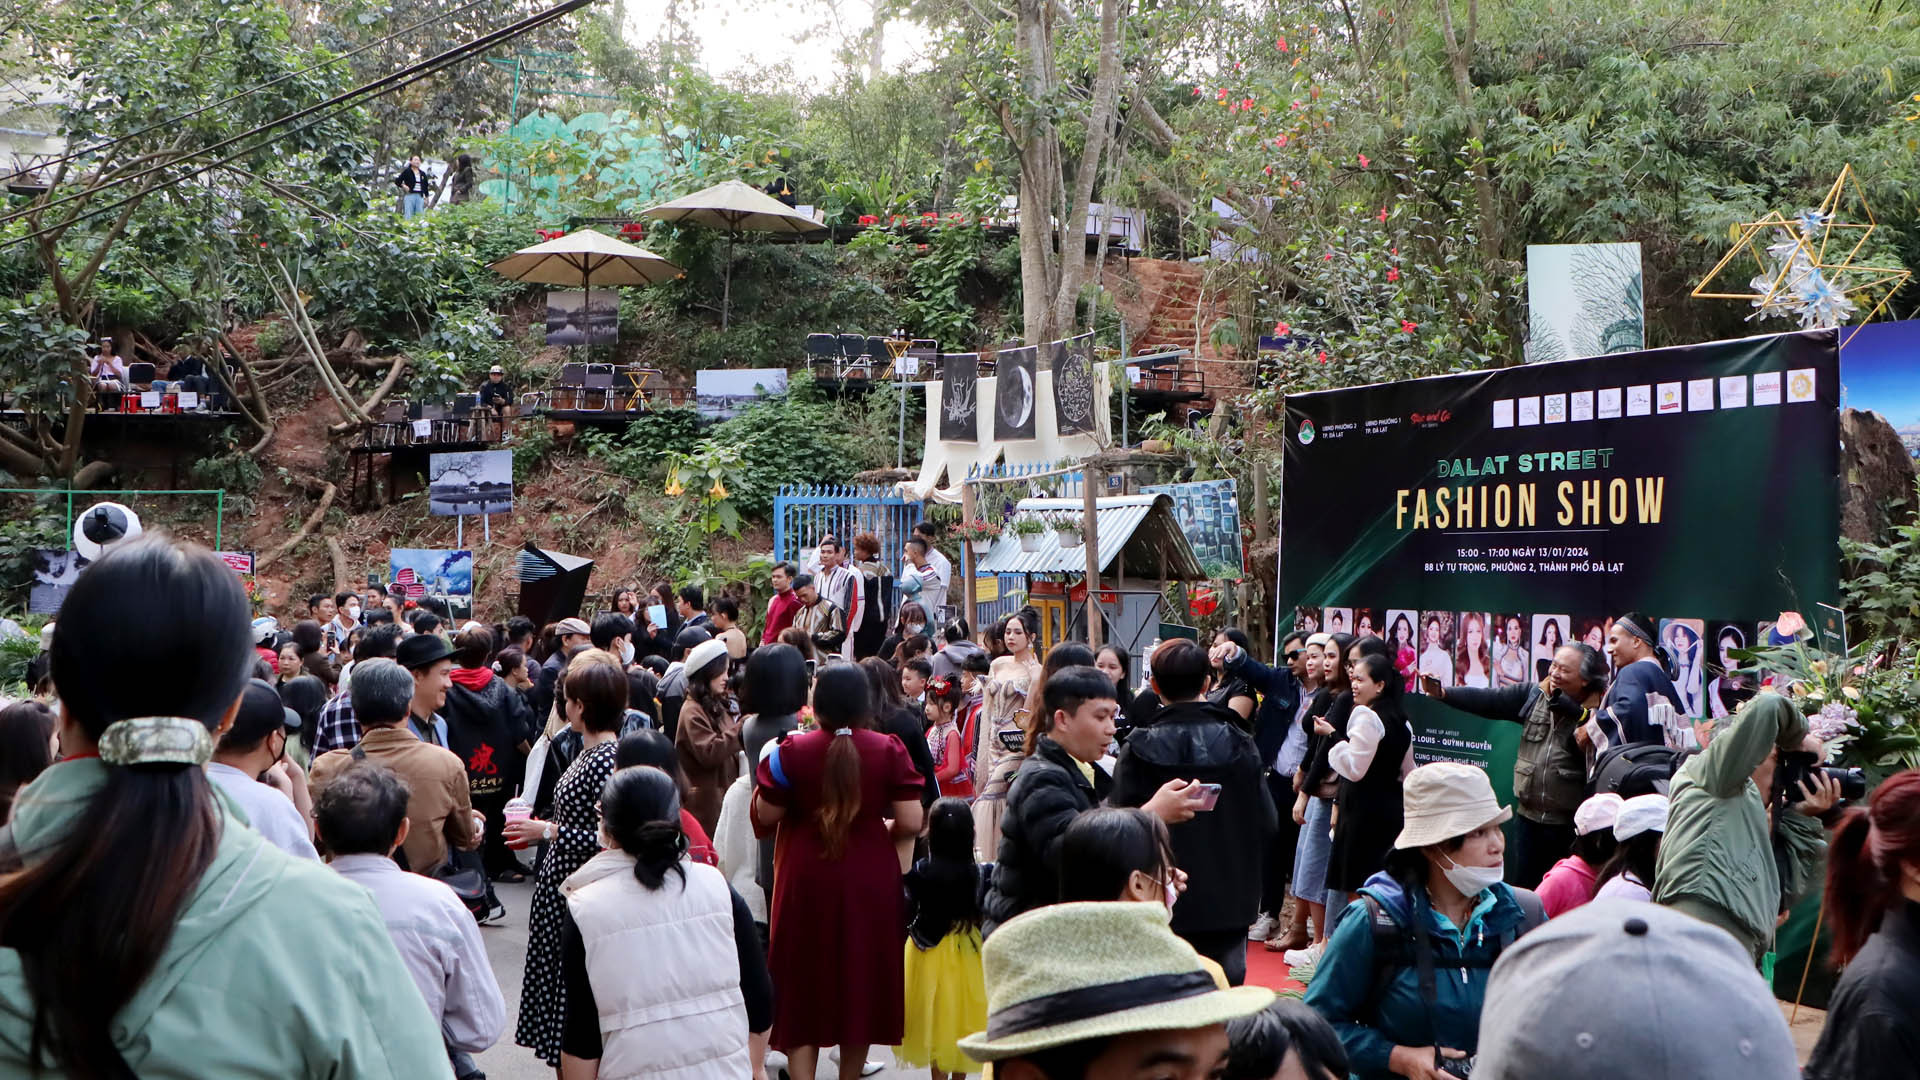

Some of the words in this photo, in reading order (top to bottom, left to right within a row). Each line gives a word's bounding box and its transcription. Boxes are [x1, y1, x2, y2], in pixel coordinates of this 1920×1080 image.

[1437, 455, 1509, 478] DALAT
[1518, 448, 1614, 473] STREET
[1396, 483, 1536, 530] FASHION
[1557, 476, 1664, 526] SHOW
[1457, 548, 1479, 557] 15:00
[1488, 548, 1510, 557] 17:00
[1512, 545, 1536, 557] NGÀY
[1539, 547, 1589, 558] 13/01/2024
[1424, 563, 1434, 571] 88
[1436, 561, 1444, 571] LÝ
[1459, 563, 1489, 573] TRỌNG,
[1491, 561, 1526, 572] PHƯỜNG
[1529, 563, 1536, 573] 2,
[1539, 561, 1568, 572] THÀNH
[1570, 560, 1589, 572] PHỐ
[1592, 561, 1605, 572] ĐÀ
[1608, 562, 1624, 574] LẠT
[1418, 736, 1436, 744] LOUIS
